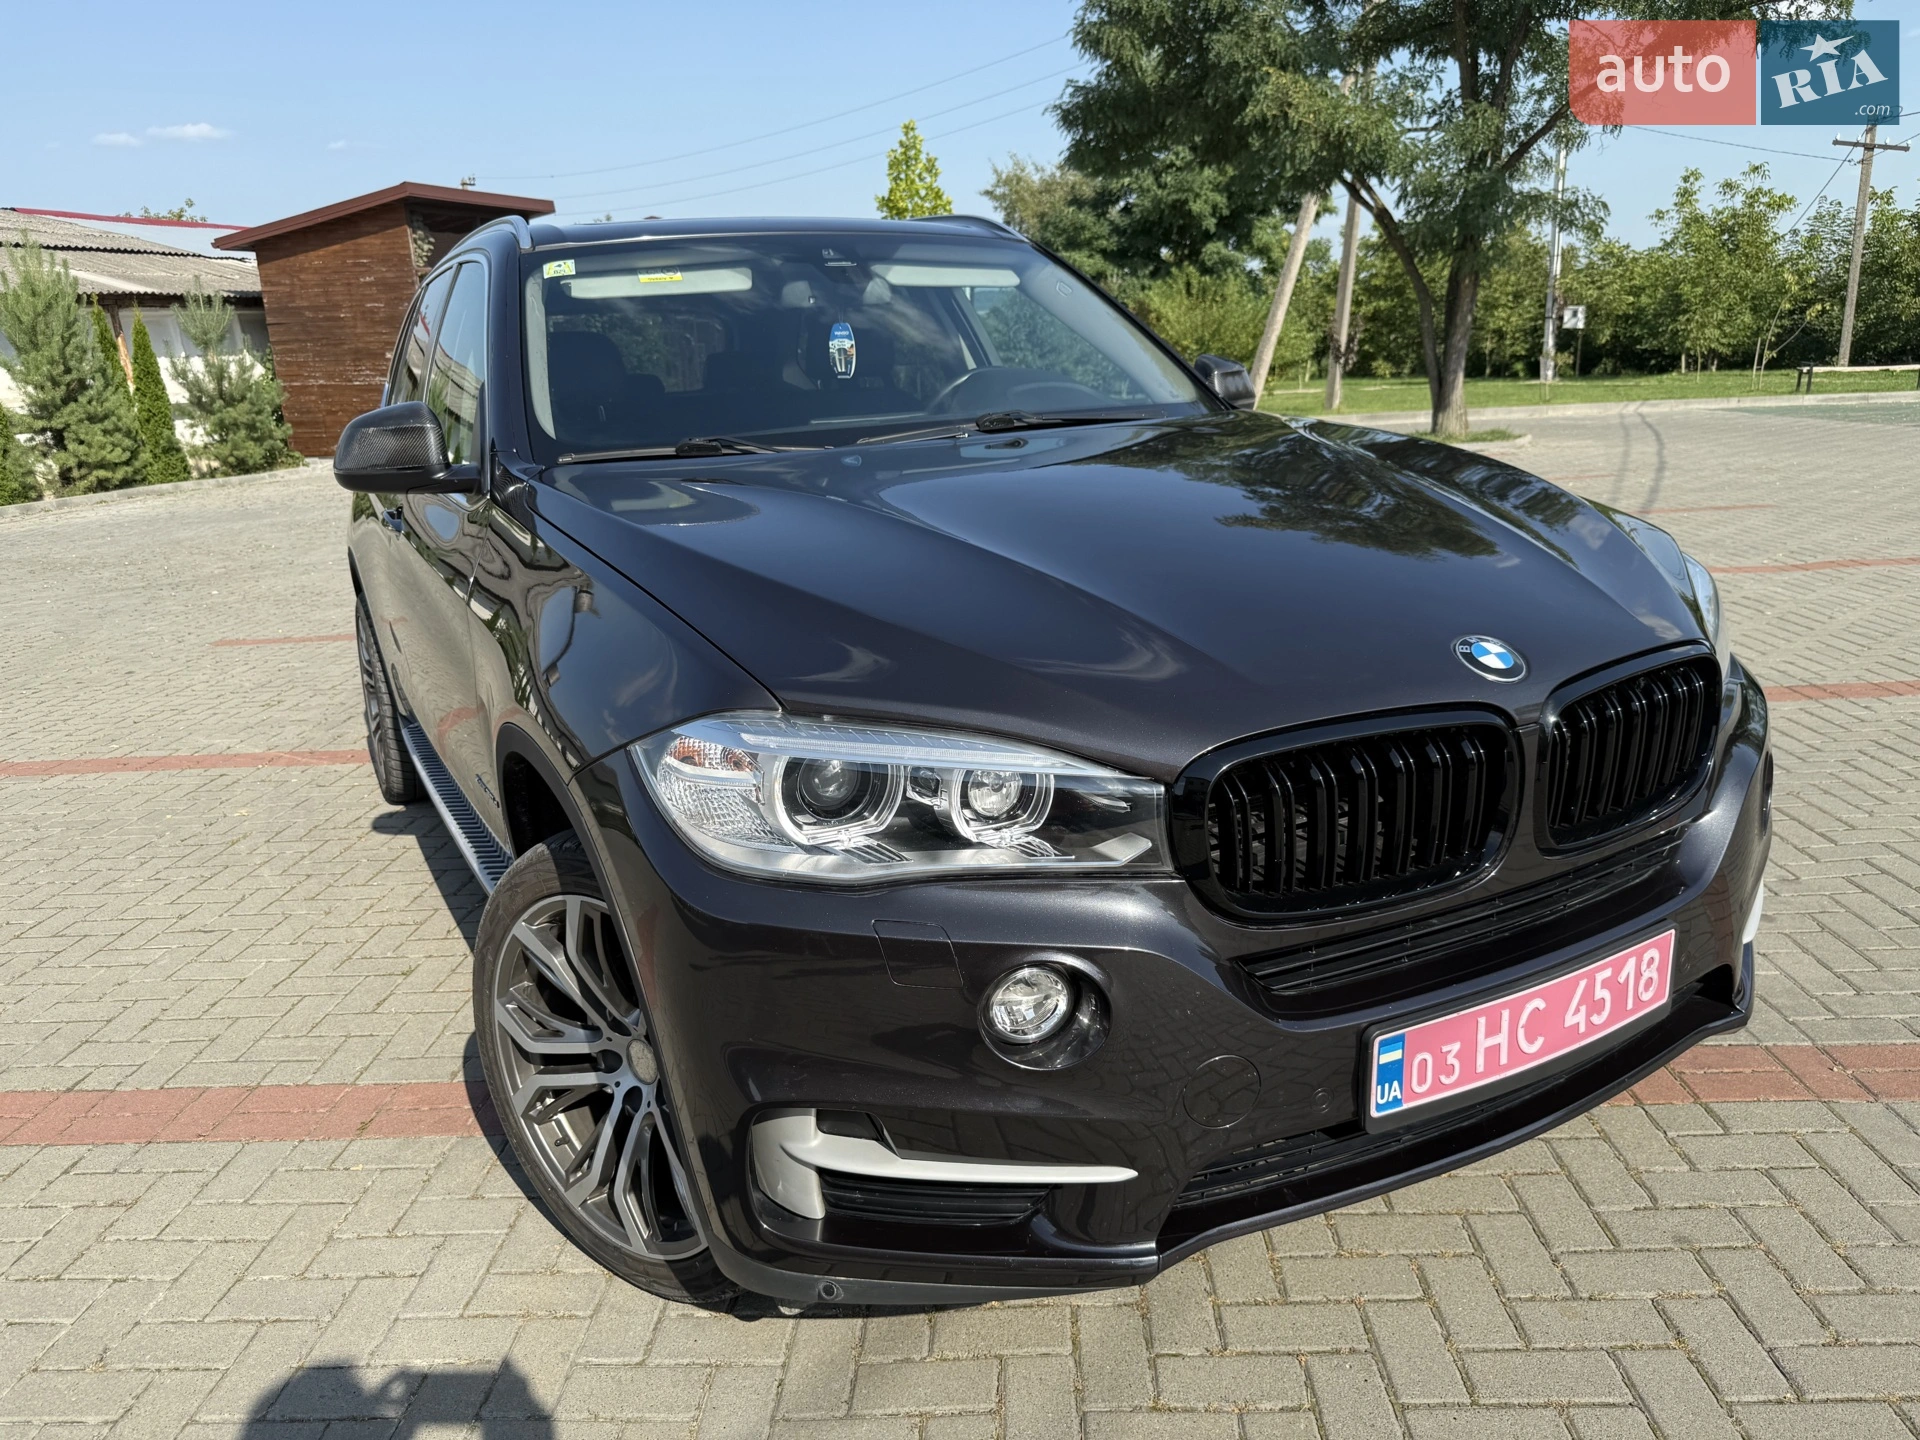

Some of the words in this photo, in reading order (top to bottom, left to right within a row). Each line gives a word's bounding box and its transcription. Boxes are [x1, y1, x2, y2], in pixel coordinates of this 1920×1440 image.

[1411, 1041, 1461, 1094] 03
[1476, 998, 1546, 1074] HC
[1563, 947, 1660, 1034] 4518
[1376, 1080, 1402, 1105] UA
